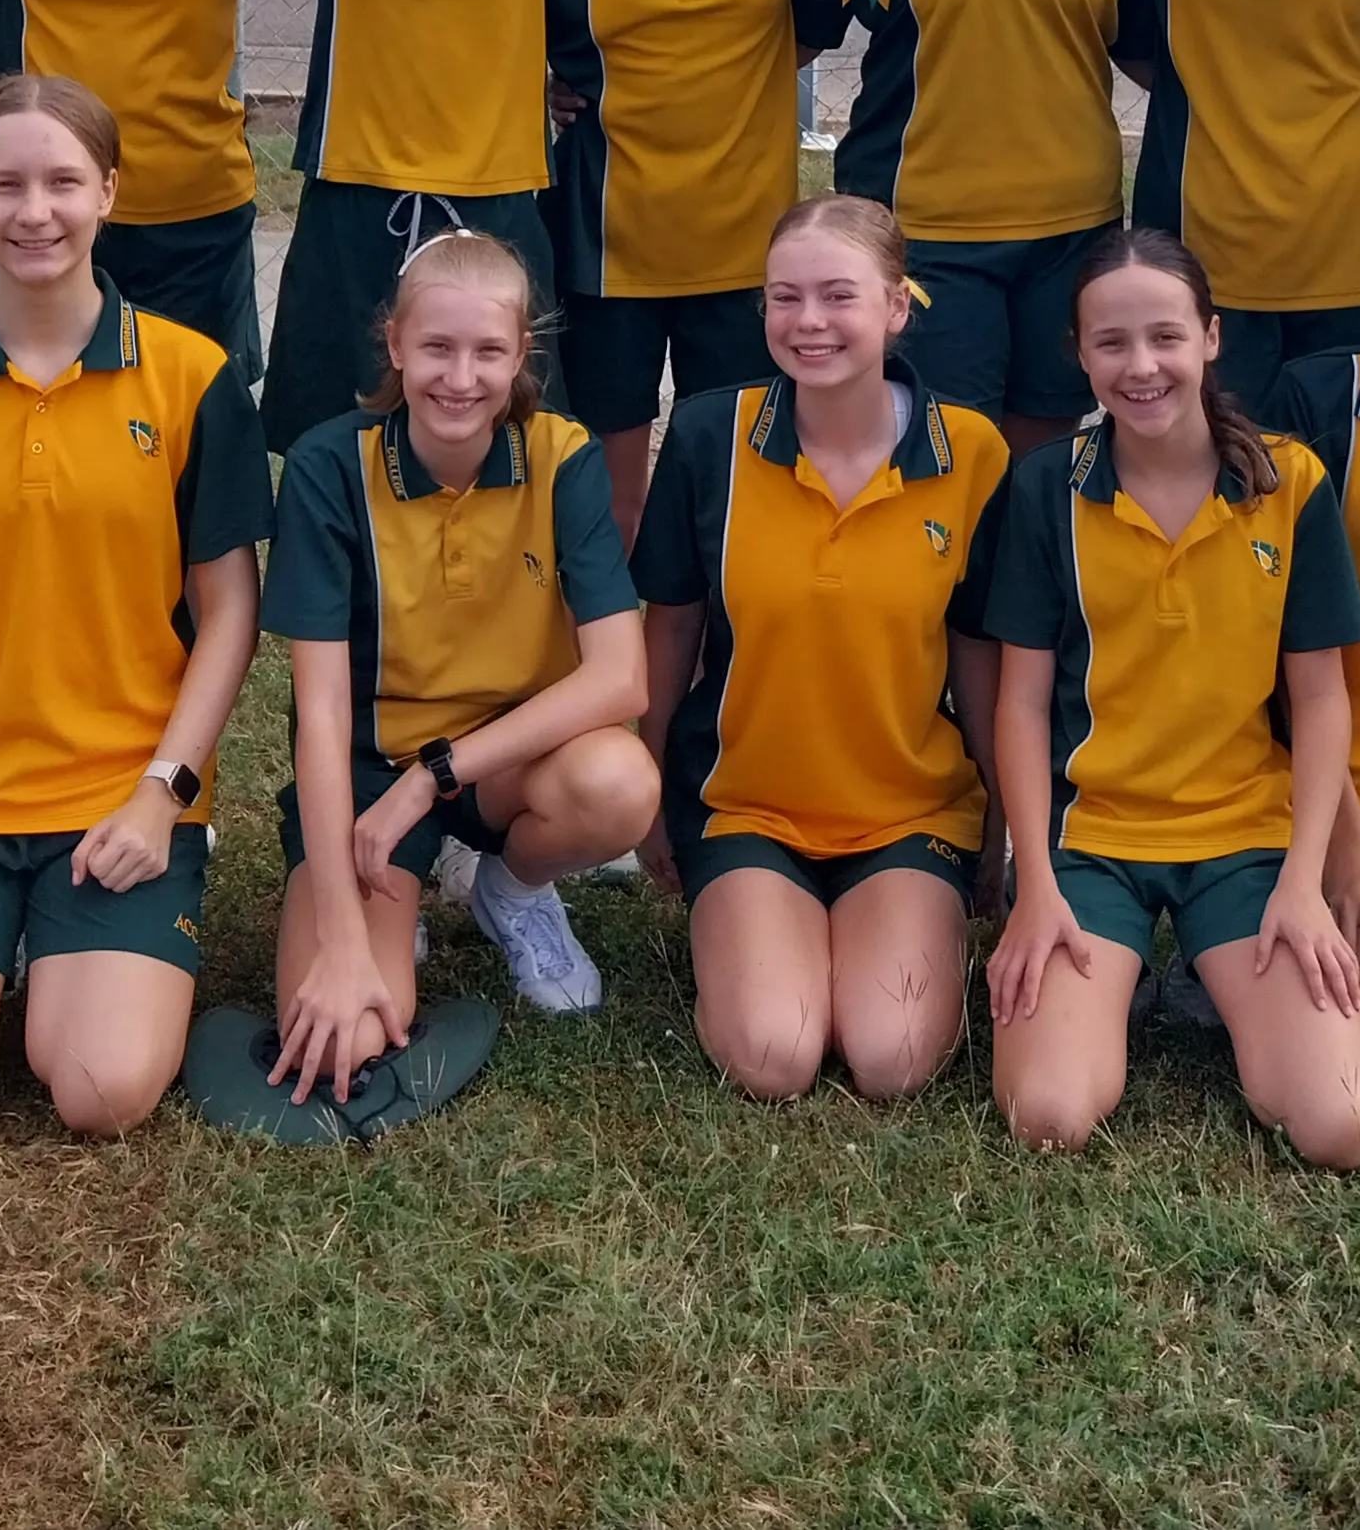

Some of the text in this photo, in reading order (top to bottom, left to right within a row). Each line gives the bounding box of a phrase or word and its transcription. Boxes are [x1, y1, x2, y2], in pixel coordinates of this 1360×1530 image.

[754, 406, 774, 447] COLLEGE
[150, 428, 162, 458] ACC
[1074, 443, 1097, 484] COLLEGE
[1272, 547, 1282, 578] ACC
[927, 837, 961, 867] ACC
[174, 912, 200, 944] ACC
